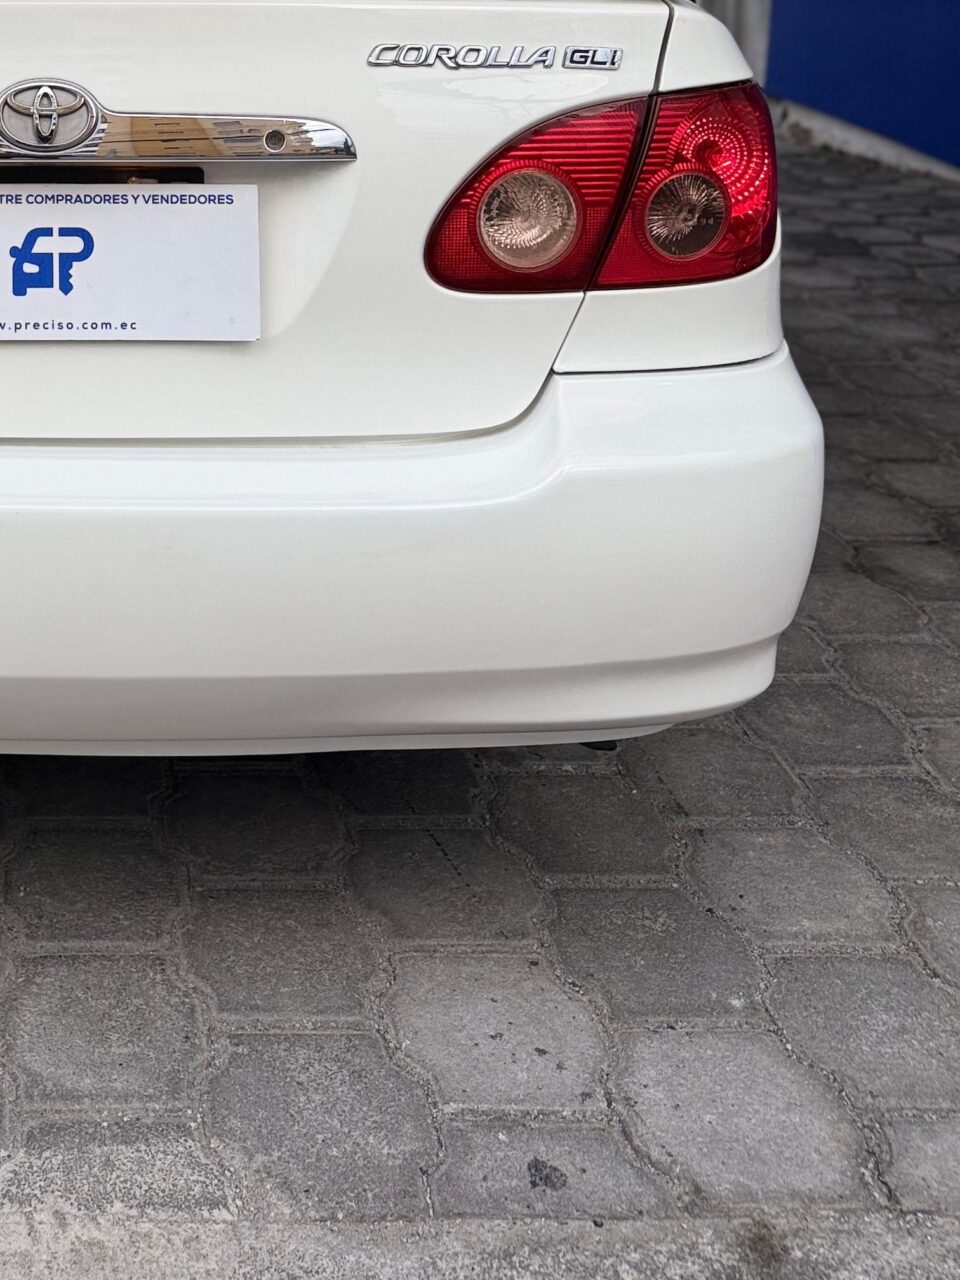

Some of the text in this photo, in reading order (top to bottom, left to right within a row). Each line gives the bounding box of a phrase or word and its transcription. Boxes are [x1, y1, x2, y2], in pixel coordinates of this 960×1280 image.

[367, 43, 556, 70] COROLLA
[25, 194, 129, 205] COMPRADORES
[131, 194, 141, 205] Y
[141, 194, 234, 205] VENDEDORES
